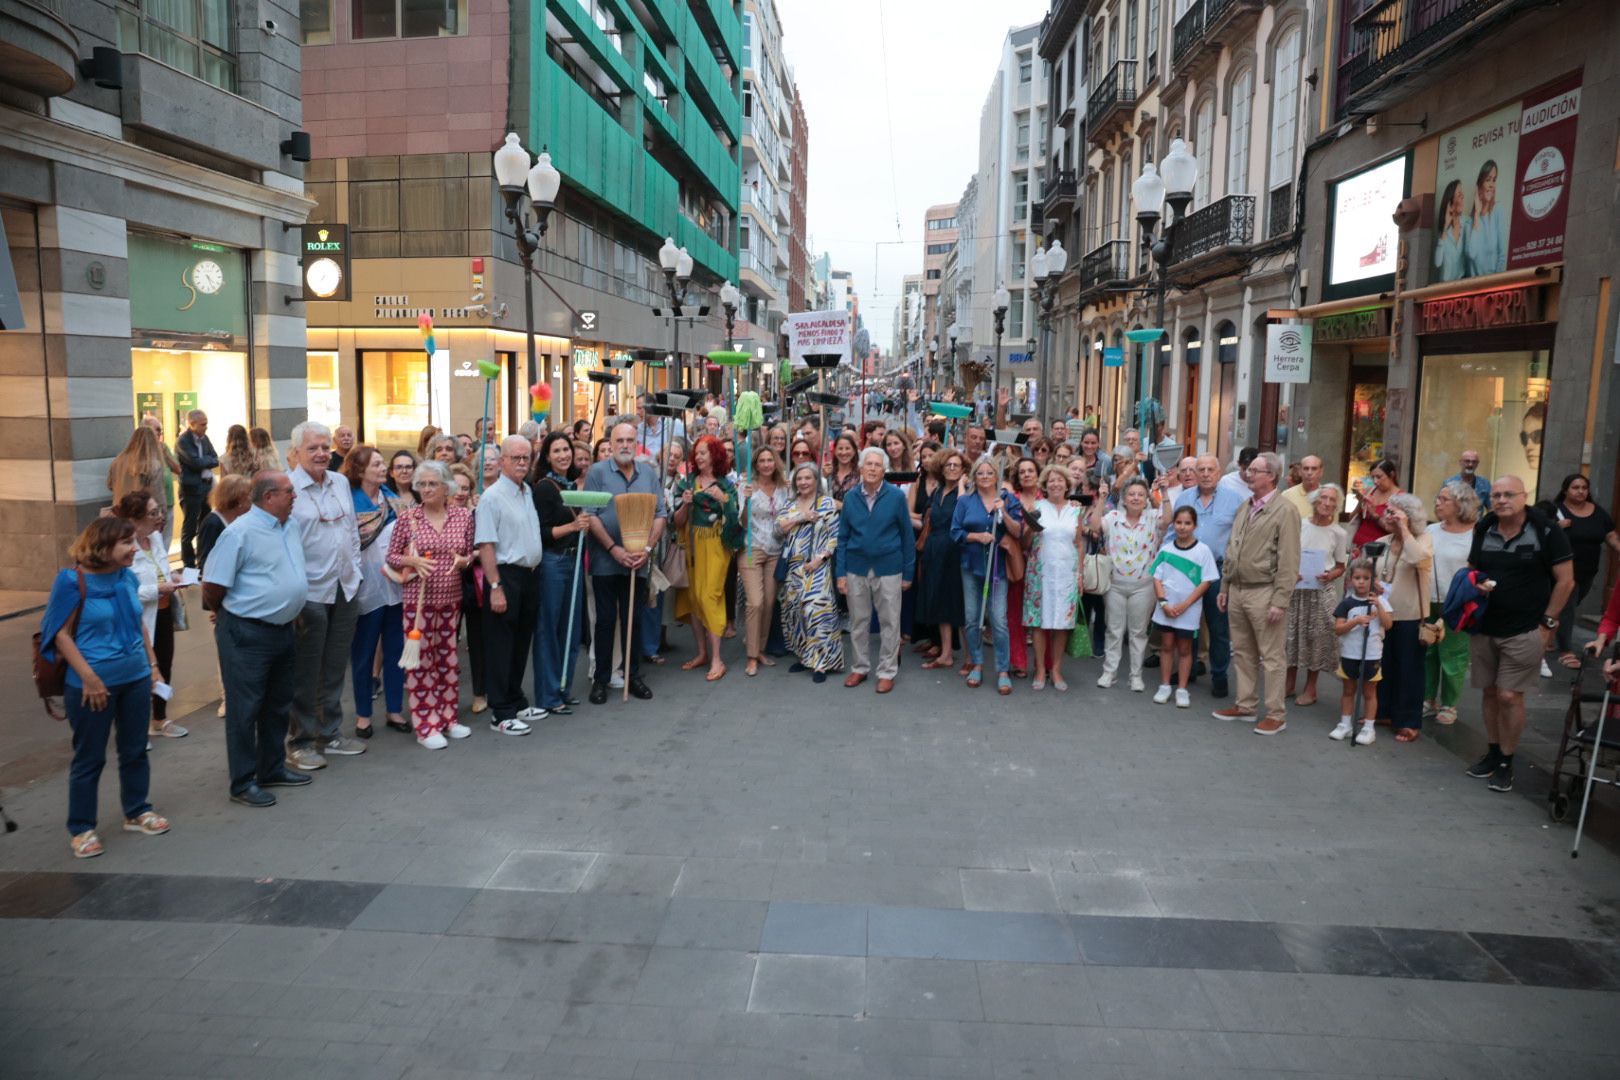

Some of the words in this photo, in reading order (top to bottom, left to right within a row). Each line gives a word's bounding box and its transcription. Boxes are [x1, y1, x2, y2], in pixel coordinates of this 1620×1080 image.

[1471, 126, 1504, 150] REVISA
[1508, 120, 1520, 134] TU
[1524, 96, 1577, 129] AUDICIÓN
[306, 242, 341, 250] ROLEX
[375, 296, 407, 305] CALLE
[443, 308, 470, 318] SECO
[1008, 352, 1033, 363] BBVA
[1273, 354, 1304, 363] Herrera
[1276, 362, 1300, 372] Cerpa
